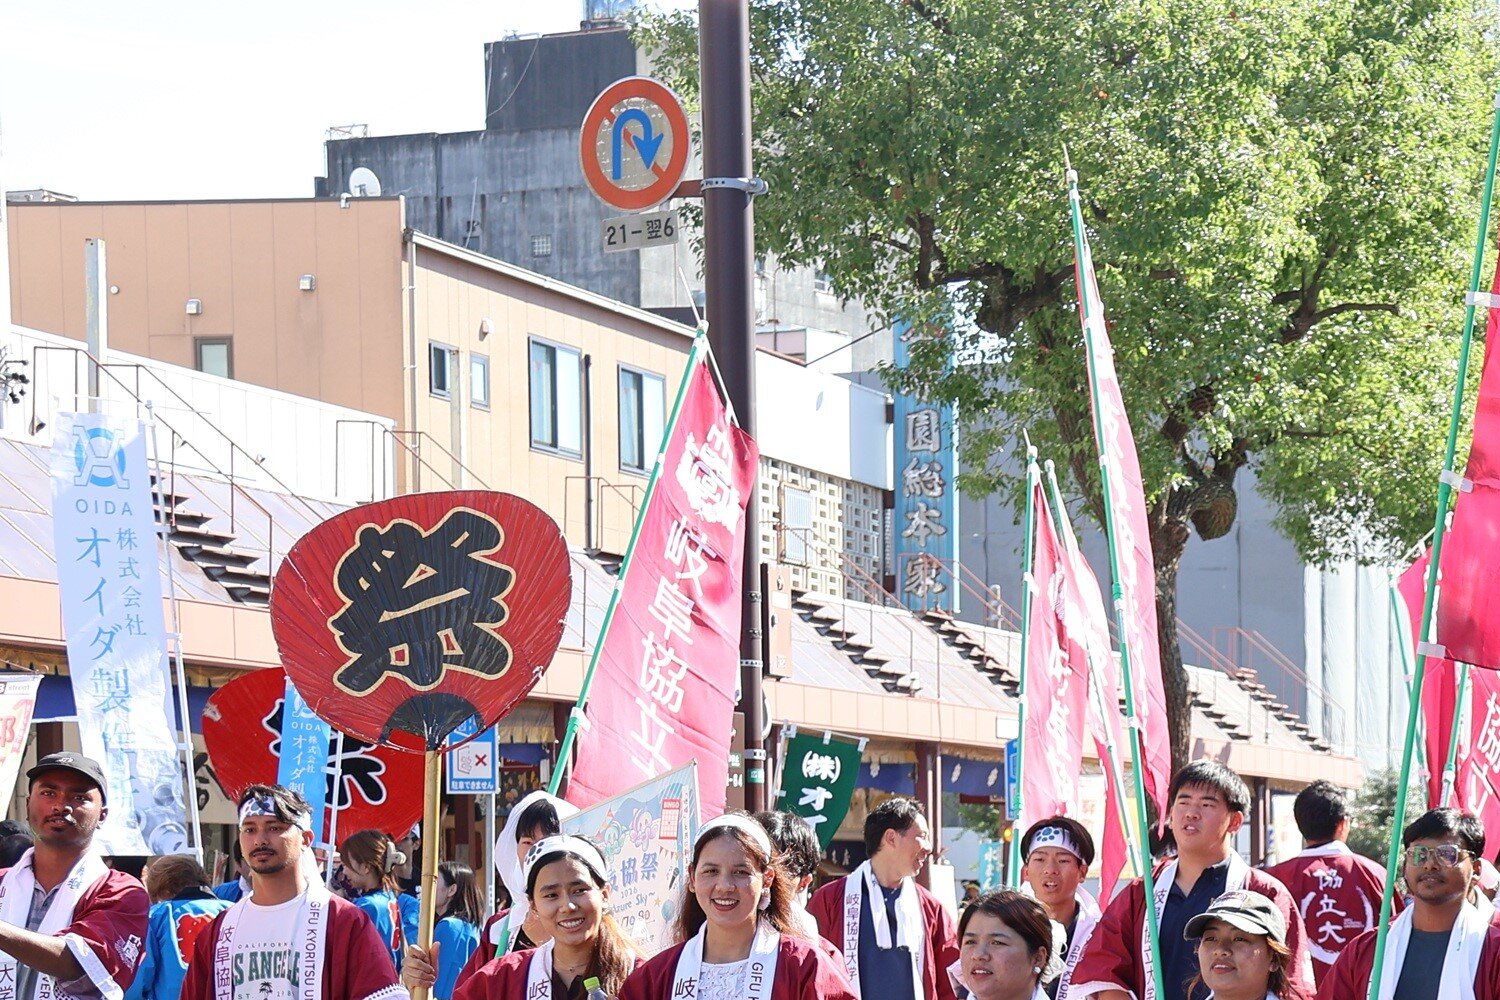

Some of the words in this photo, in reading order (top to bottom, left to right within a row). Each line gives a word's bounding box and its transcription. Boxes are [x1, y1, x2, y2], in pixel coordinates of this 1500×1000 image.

[75, 499, 133, 516] OIDA
[115, 527, 146, 636] 株式会社
[328, 507, 516, 696] 祭
[291, 721, 322, 732] OIDA
[663, 801, 679, 810] BINGO
[308, 902, 321, 925] GIFU
[1312, 868, 1347, 943] 協立大
[846, 893, 860, 981] 岐阜協立大学
[232, 953, 244, 986] S
[304, 929, 318, 986] KYORITSU
[748, 962, 764, 993] GIFU
